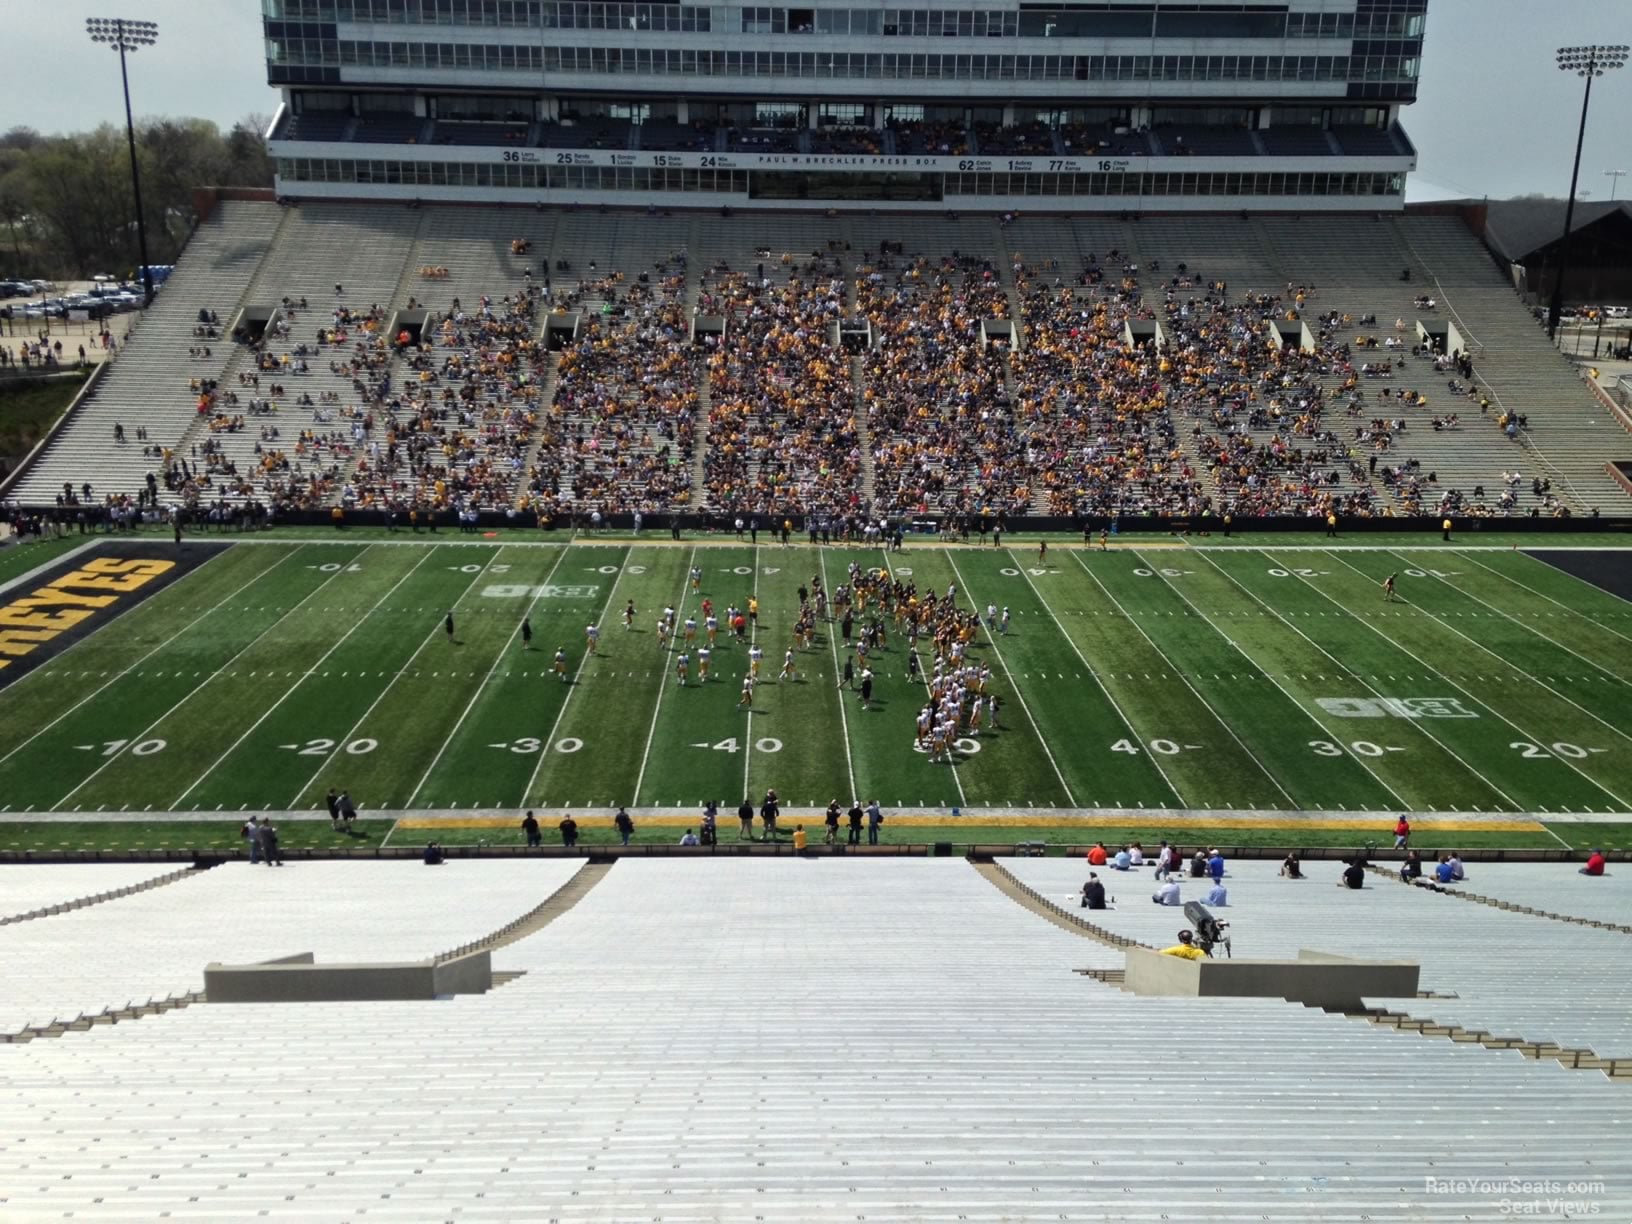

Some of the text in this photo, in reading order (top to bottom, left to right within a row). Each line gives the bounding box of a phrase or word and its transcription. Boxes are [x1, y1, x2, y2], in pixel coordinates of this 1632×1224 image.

[503, 151, 519, 162] 36
[557, 153, 573, 163] 25
[611, 154, 616, 165] 1
[653, 155, 666, 166] 15
[701, 156, 716, 167] 24
[959, 160, 974, 171] 62
[1008, 160, 1013, 170] 1
[1049, 160, 1063, 171] 77
[1098, 160, 1111, 171] 16
[100, 739, 167, 755] 10
[298, 738, 378, 755] 20
[510, 737, 584, 754] 30
[712, 737, 783, 753] 40
[1111, 739, 1180, 755] 40
[1308, 740, 1383, 757] 30
[1509, 742, 1588, 758] 20
